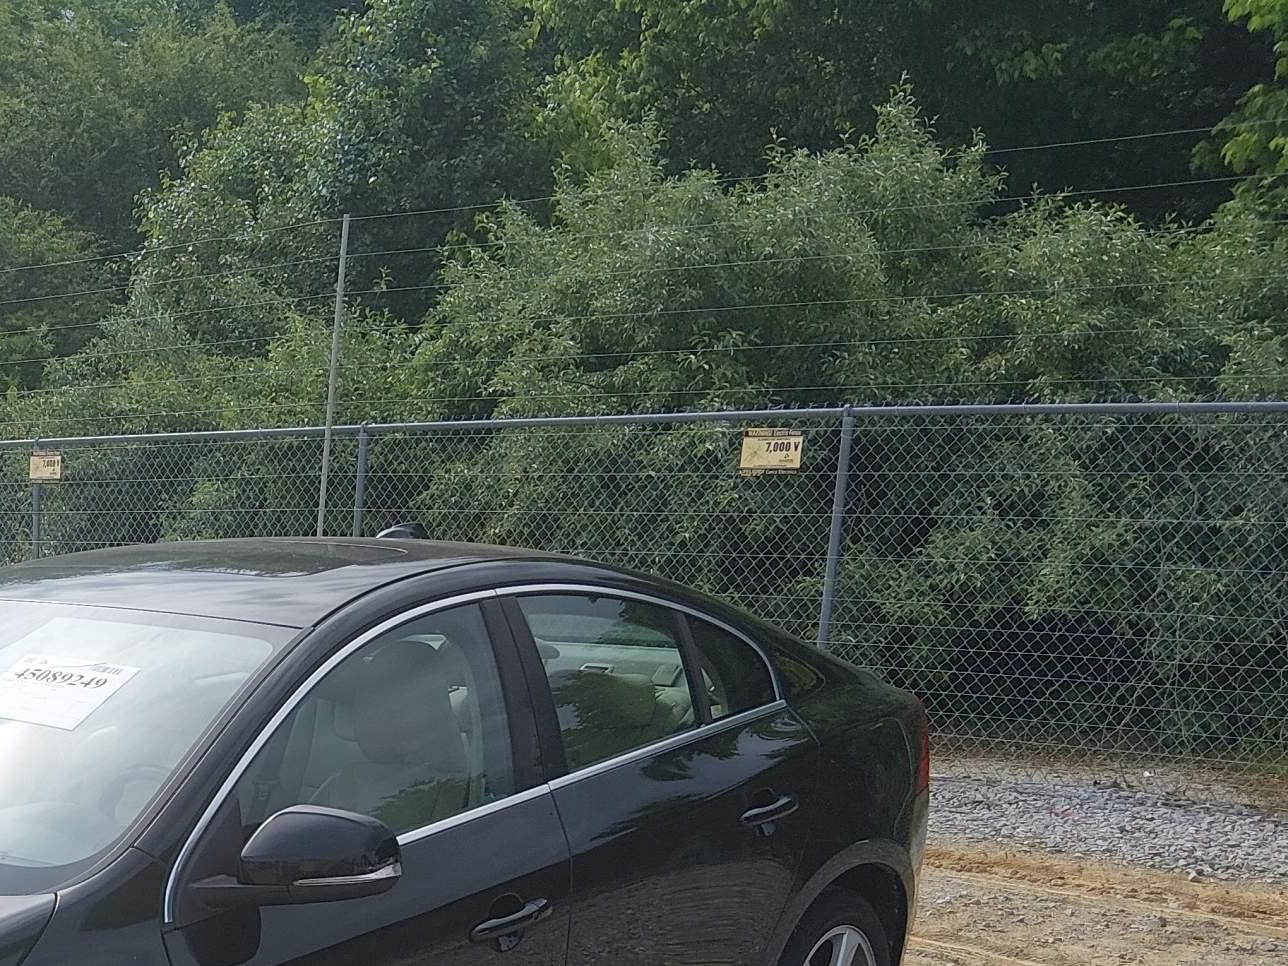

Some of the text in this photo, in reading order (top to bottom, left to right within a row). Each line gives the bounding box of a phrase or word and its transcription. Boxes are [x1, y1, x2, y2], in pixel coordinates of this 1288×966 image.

[765, 441, 801, 453] 7,000 V
[15, 668, 108, 689] 45089249
